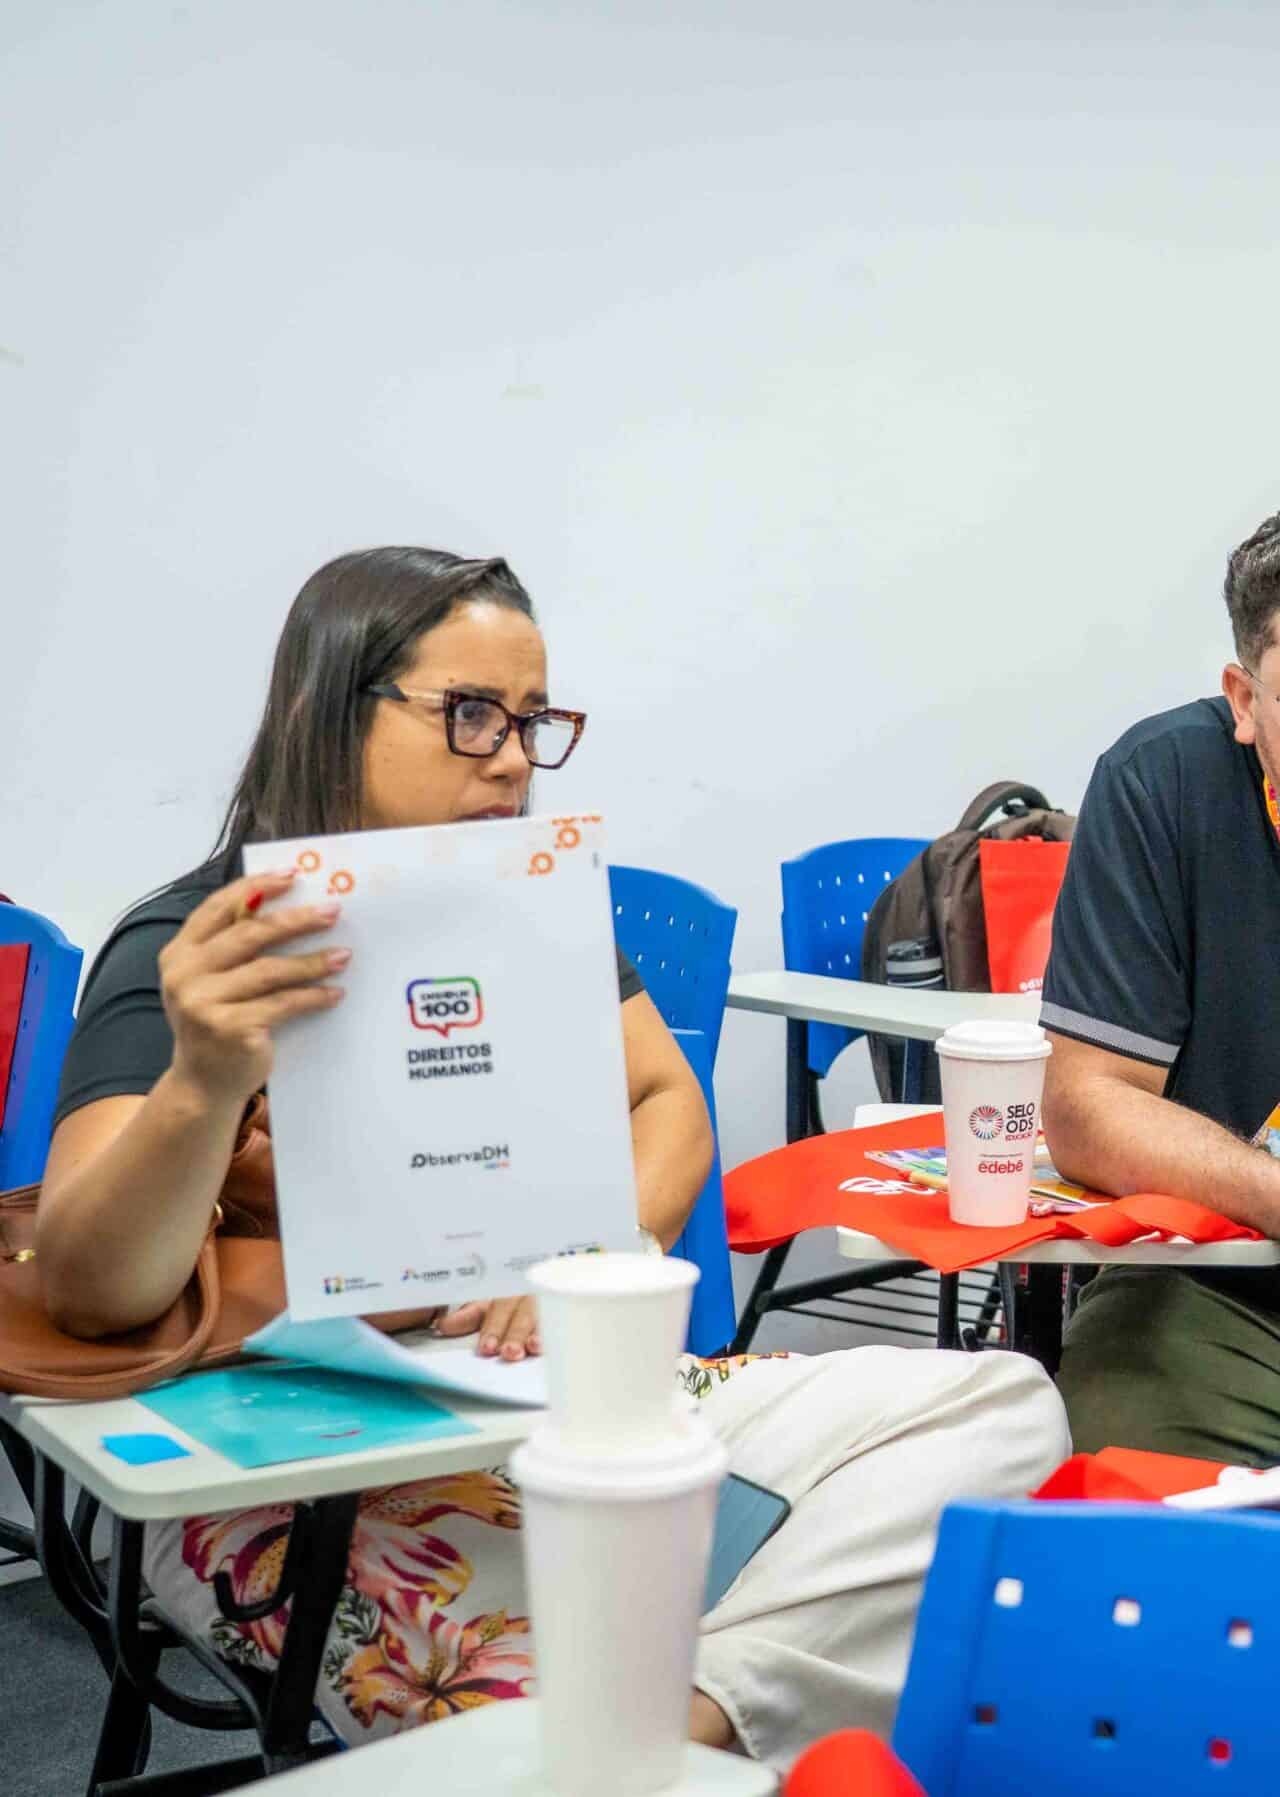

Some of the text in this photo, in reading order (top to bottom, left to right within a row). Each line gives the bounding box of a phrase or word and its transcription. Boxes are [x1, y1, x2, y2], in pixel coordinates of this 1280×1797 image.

[420, 1000, 470, 1017] 100
[408, 1043, 491, 1063] DIREITOS
[409, 1061, 494, 1080] HUMANOS
[1007, 1102, 1035, 1118] SELO
[1006, 1117, 1033, 1133] ODS
[411, 1144, 509, 1168] ObservaDH
